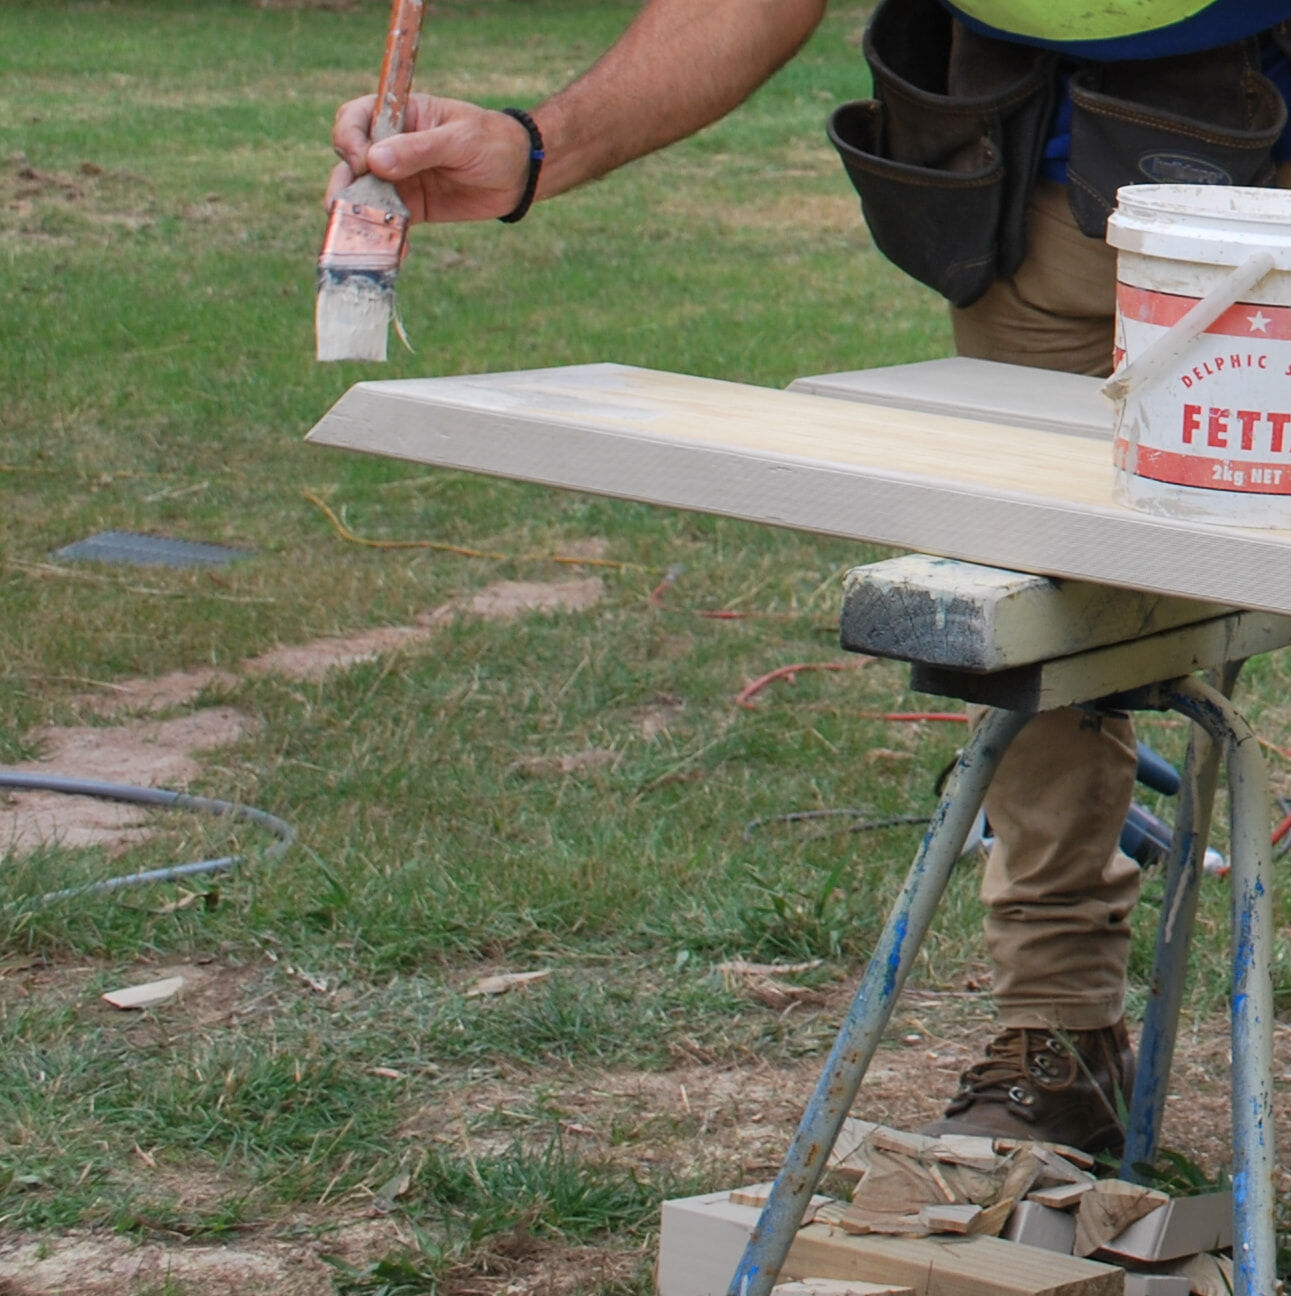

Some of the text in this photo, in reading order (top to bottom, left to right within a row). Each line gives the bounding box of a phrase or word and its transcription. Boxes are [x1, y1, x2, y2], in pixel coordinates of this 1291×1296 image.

[1181, 354, 1267, 388] DELPHIC
[1212, 465, 1283, 486] 2kg NET
